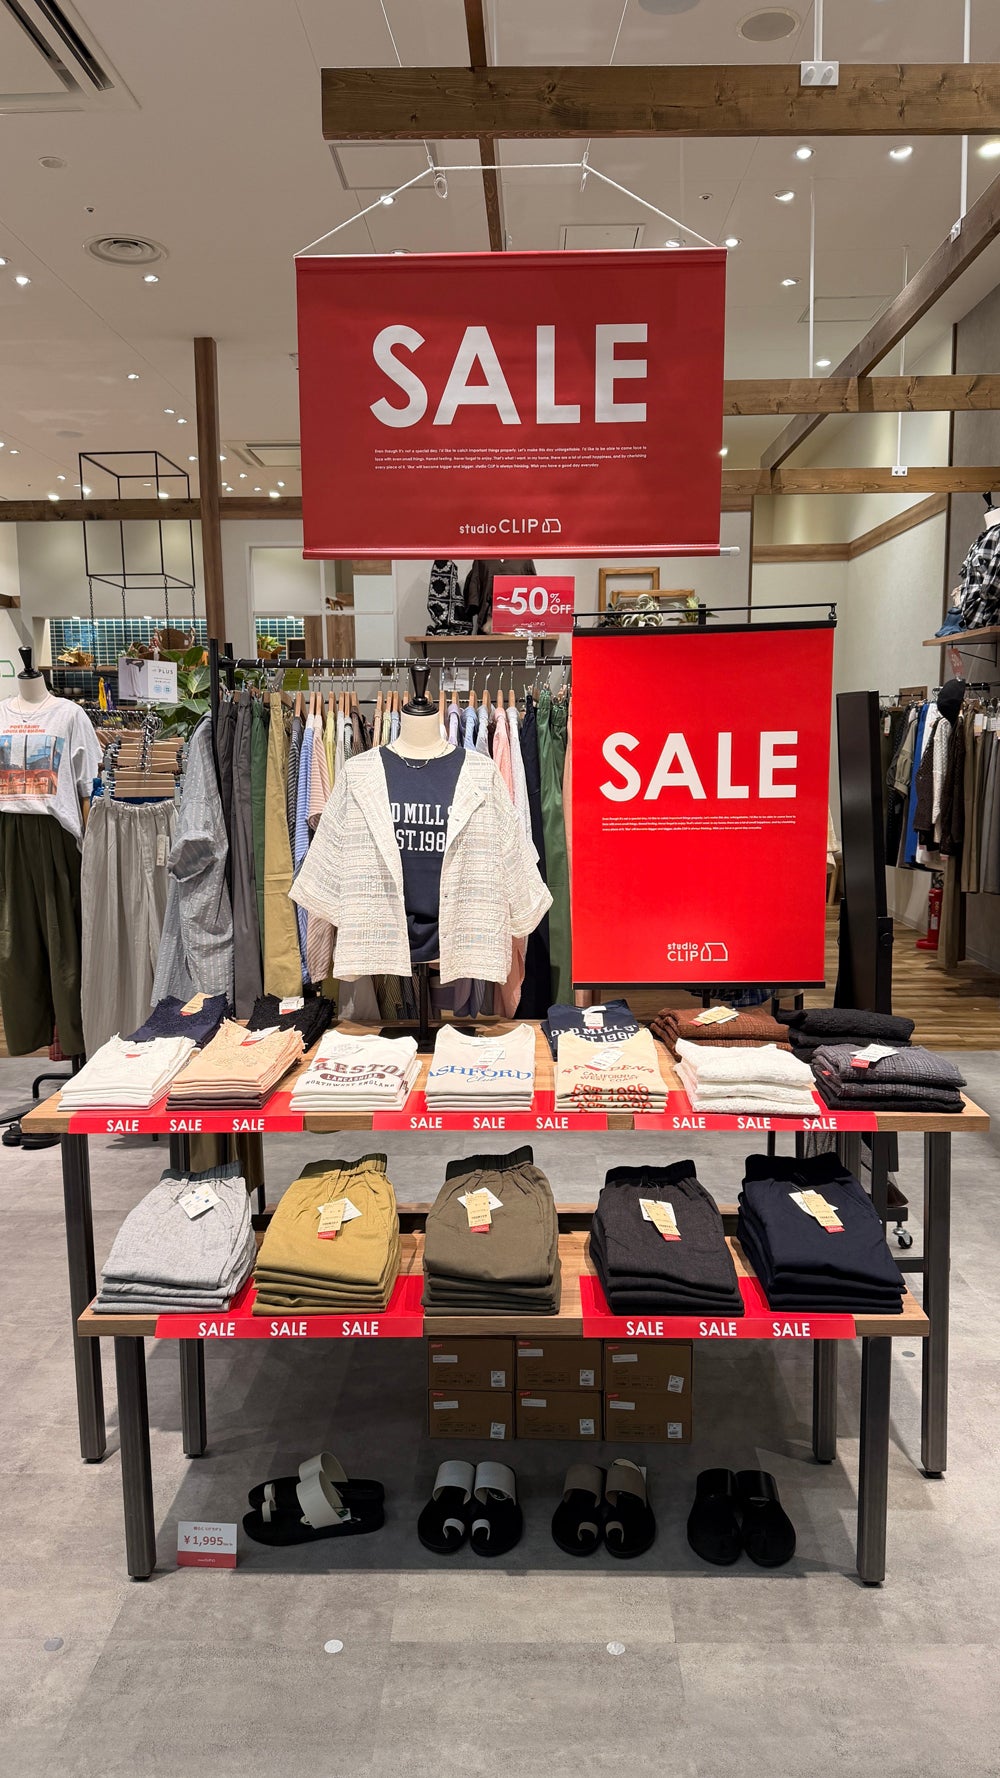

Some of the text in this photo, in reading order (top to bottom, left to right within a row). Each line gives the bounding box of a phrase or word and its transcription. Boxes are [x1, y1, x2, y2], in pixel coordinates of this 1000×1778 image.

[370, 324, 648, 427] SALE
[459, 518, 539, 534] studio CLIP
[550, 604, 571, 614] OFF
[600, 731, 797, 802] SALE
[396, 829, 445, 852] ST.198
[668, 951, 698, 961] CLIP
[307, 1062, 405, 1078] RESTO
[106, 1119, 264, 1132] SALE SALE SALE
[410, 1117, 568, 1129] SALE SALE SALE
[673, 1117, 837, 1130] SALE SALE SALE
[198, 1322, 379, 1336] SALE SALE SALE
[626, 1322, 810, 1336] SALE SALE SALE
